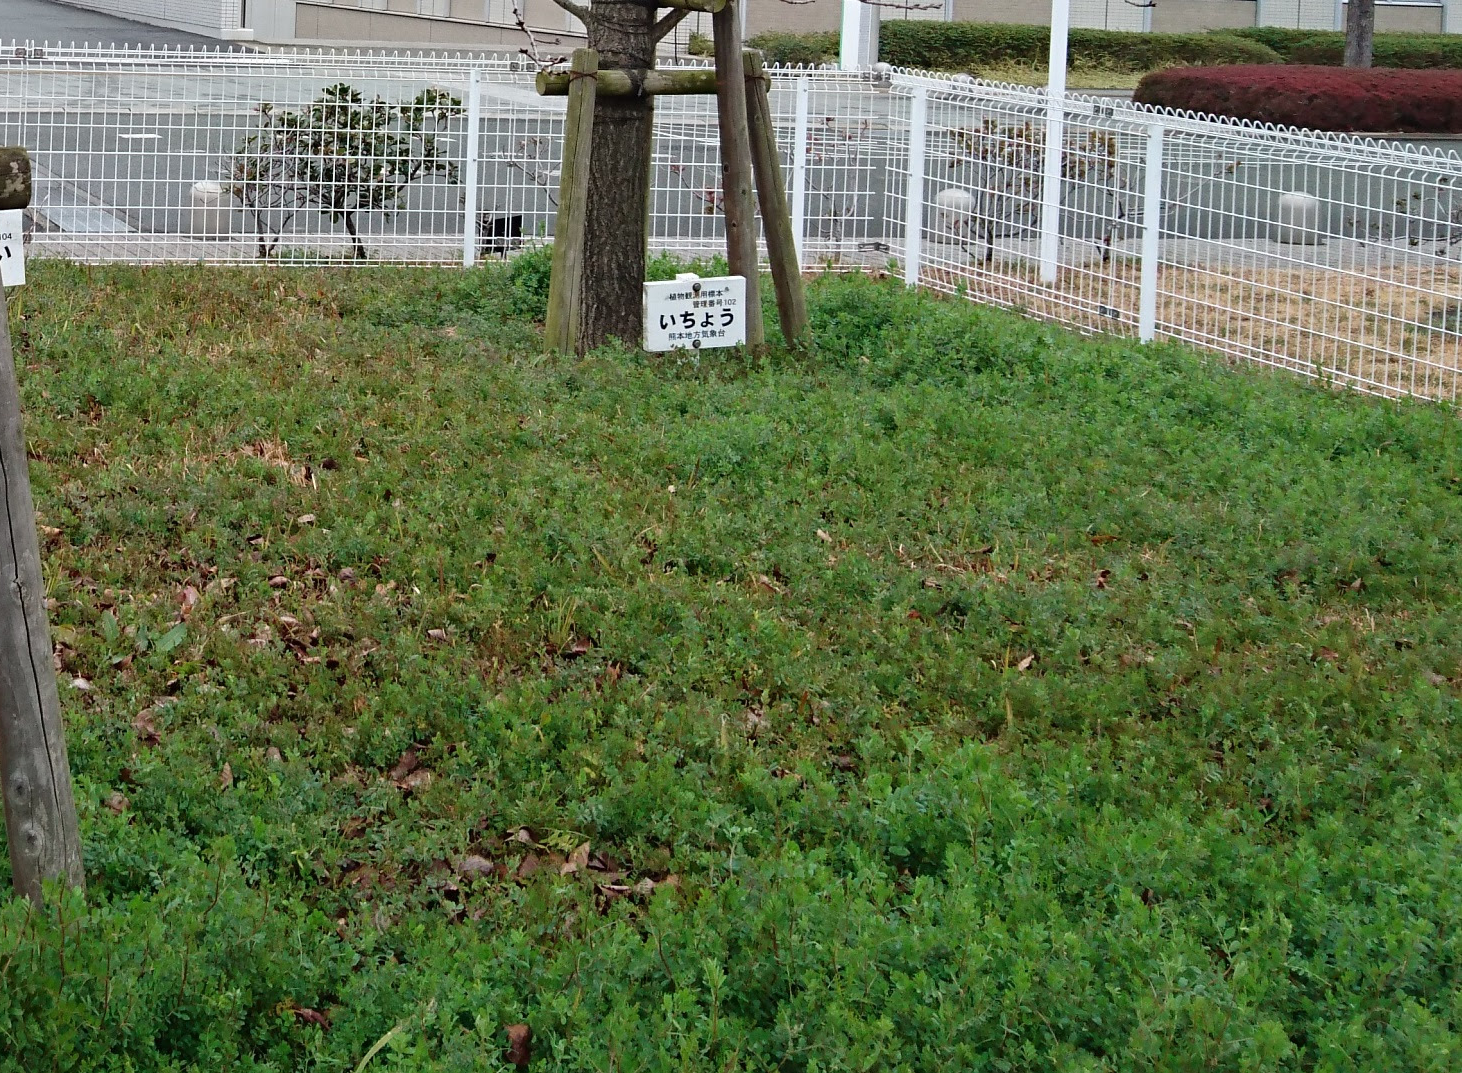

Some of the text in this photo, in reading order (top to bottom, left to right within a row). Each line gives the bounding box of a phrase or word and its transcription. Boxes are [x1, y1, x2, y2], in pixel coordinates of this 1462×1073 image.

[660, 308, 734, 330] いちょう
[668, 329, 725, 341] 熊本地方気象台
